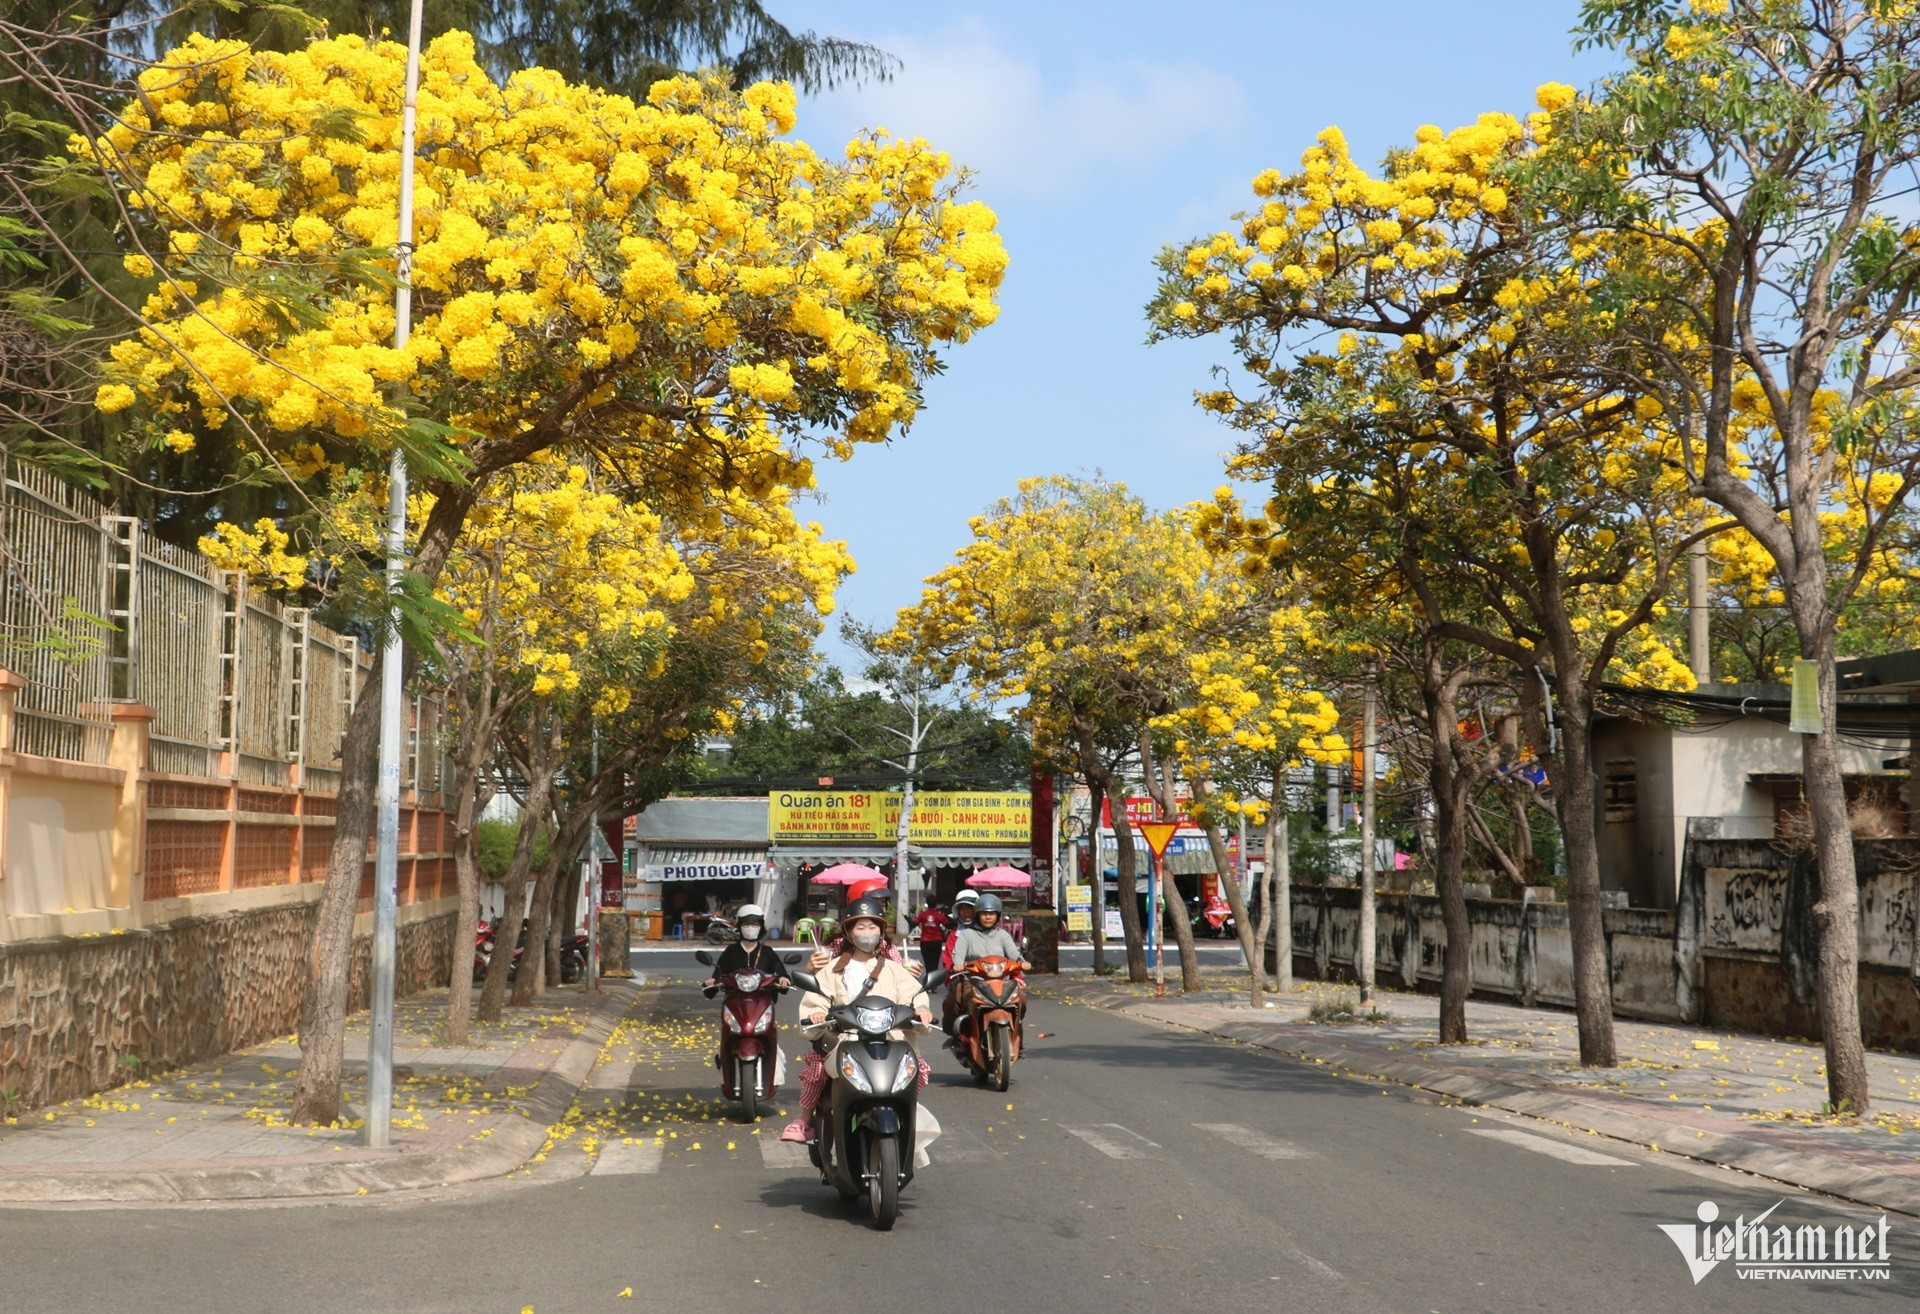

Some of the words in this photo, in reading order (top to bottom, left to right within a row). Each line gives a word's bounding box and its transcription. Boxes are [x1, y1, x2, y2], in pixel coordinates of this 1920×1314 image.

[780, 794, 822, 808] Quán
[826, 794, 844, 808] ăn
[849, 794, 871, 808] 181
[885, 797, 899, 806] CƠM
[924, 797, 938, 806] CƠM
[957, 797, 971, 807] CƠM
[973, 798, 983, 807] GIA
[1006, 797, 1020, 807] CƠM
[1126, 804, 1136, 812] XE
[952, 813, 978, 824] CANH
[981, 813, 1005, 824] CHUA
[780, 822, 804, 830] BÁNH
[664, 864, 762, 879] PHOTOCOPY
